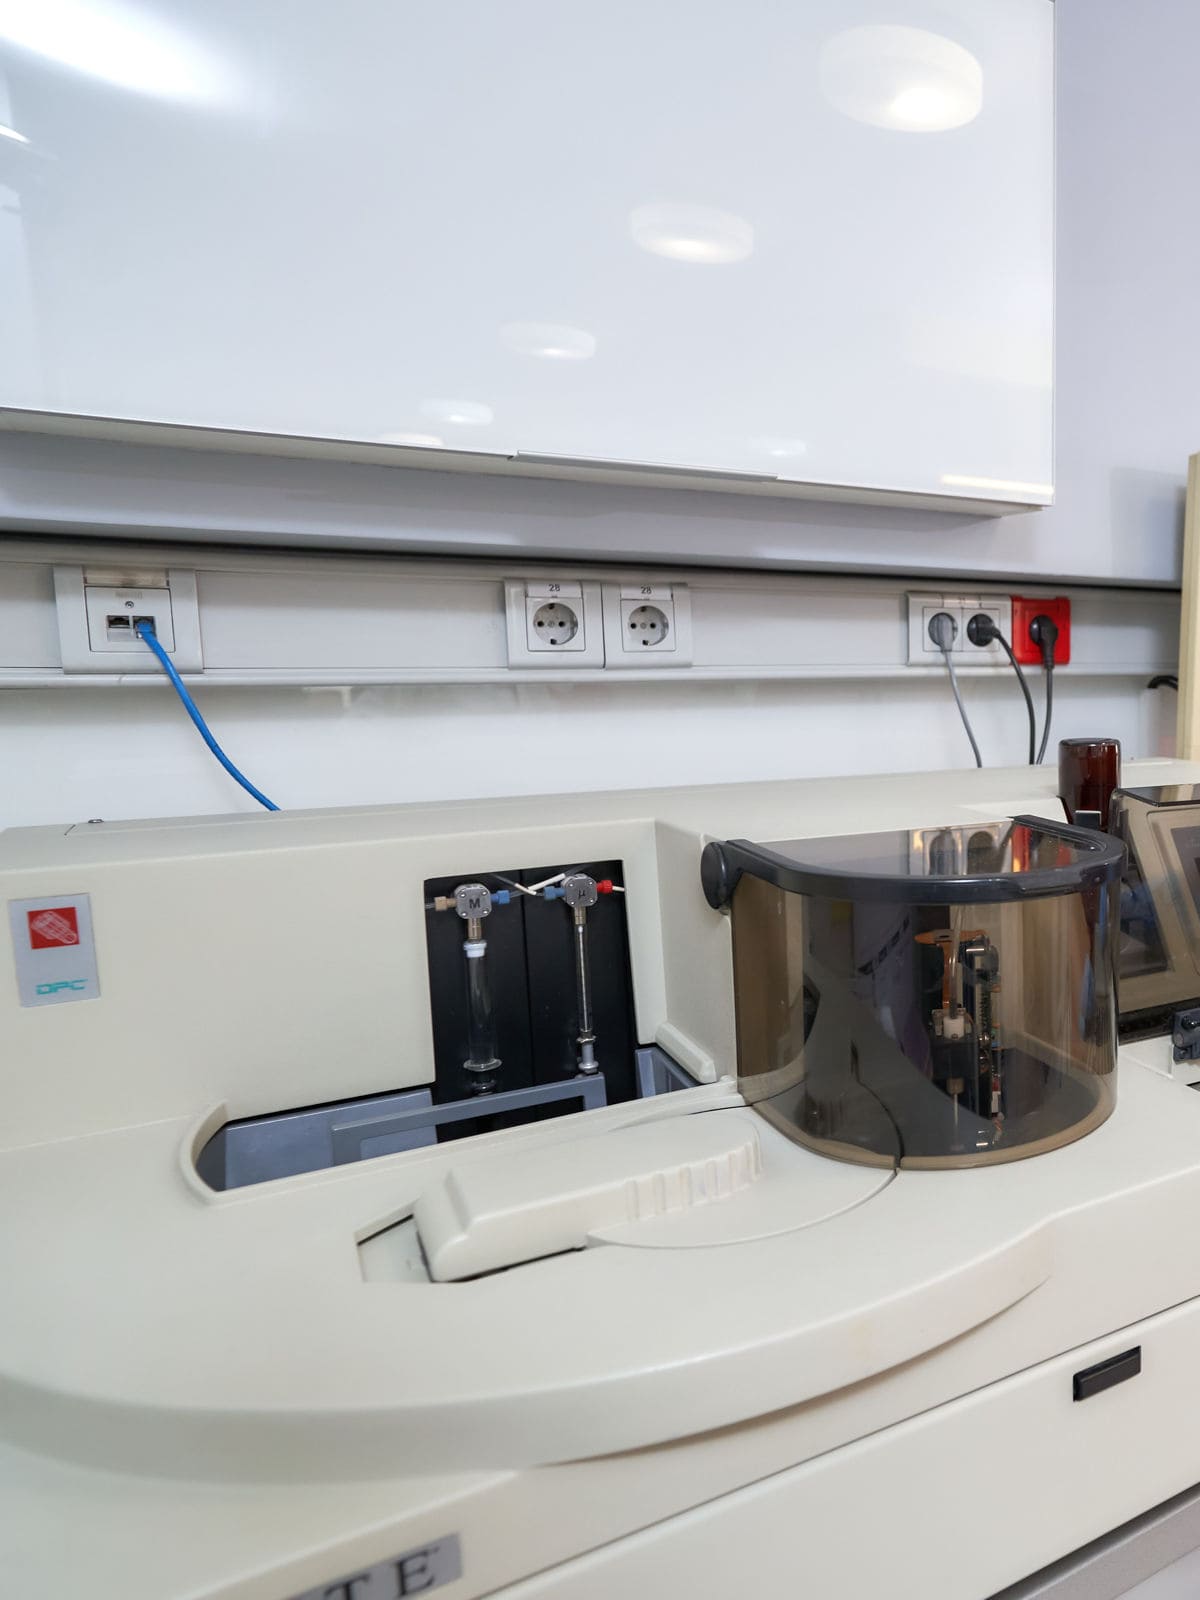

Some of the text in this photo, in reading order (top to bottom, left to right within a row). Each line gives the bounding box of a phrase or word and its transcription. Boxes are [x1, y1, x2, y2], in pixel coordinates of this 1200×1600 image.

[548, 583, 561, 592] 28
[640, 585, 652, 595] 28
[469, 898, 481, 909] M
[35, 978, 88, 995] DPC
